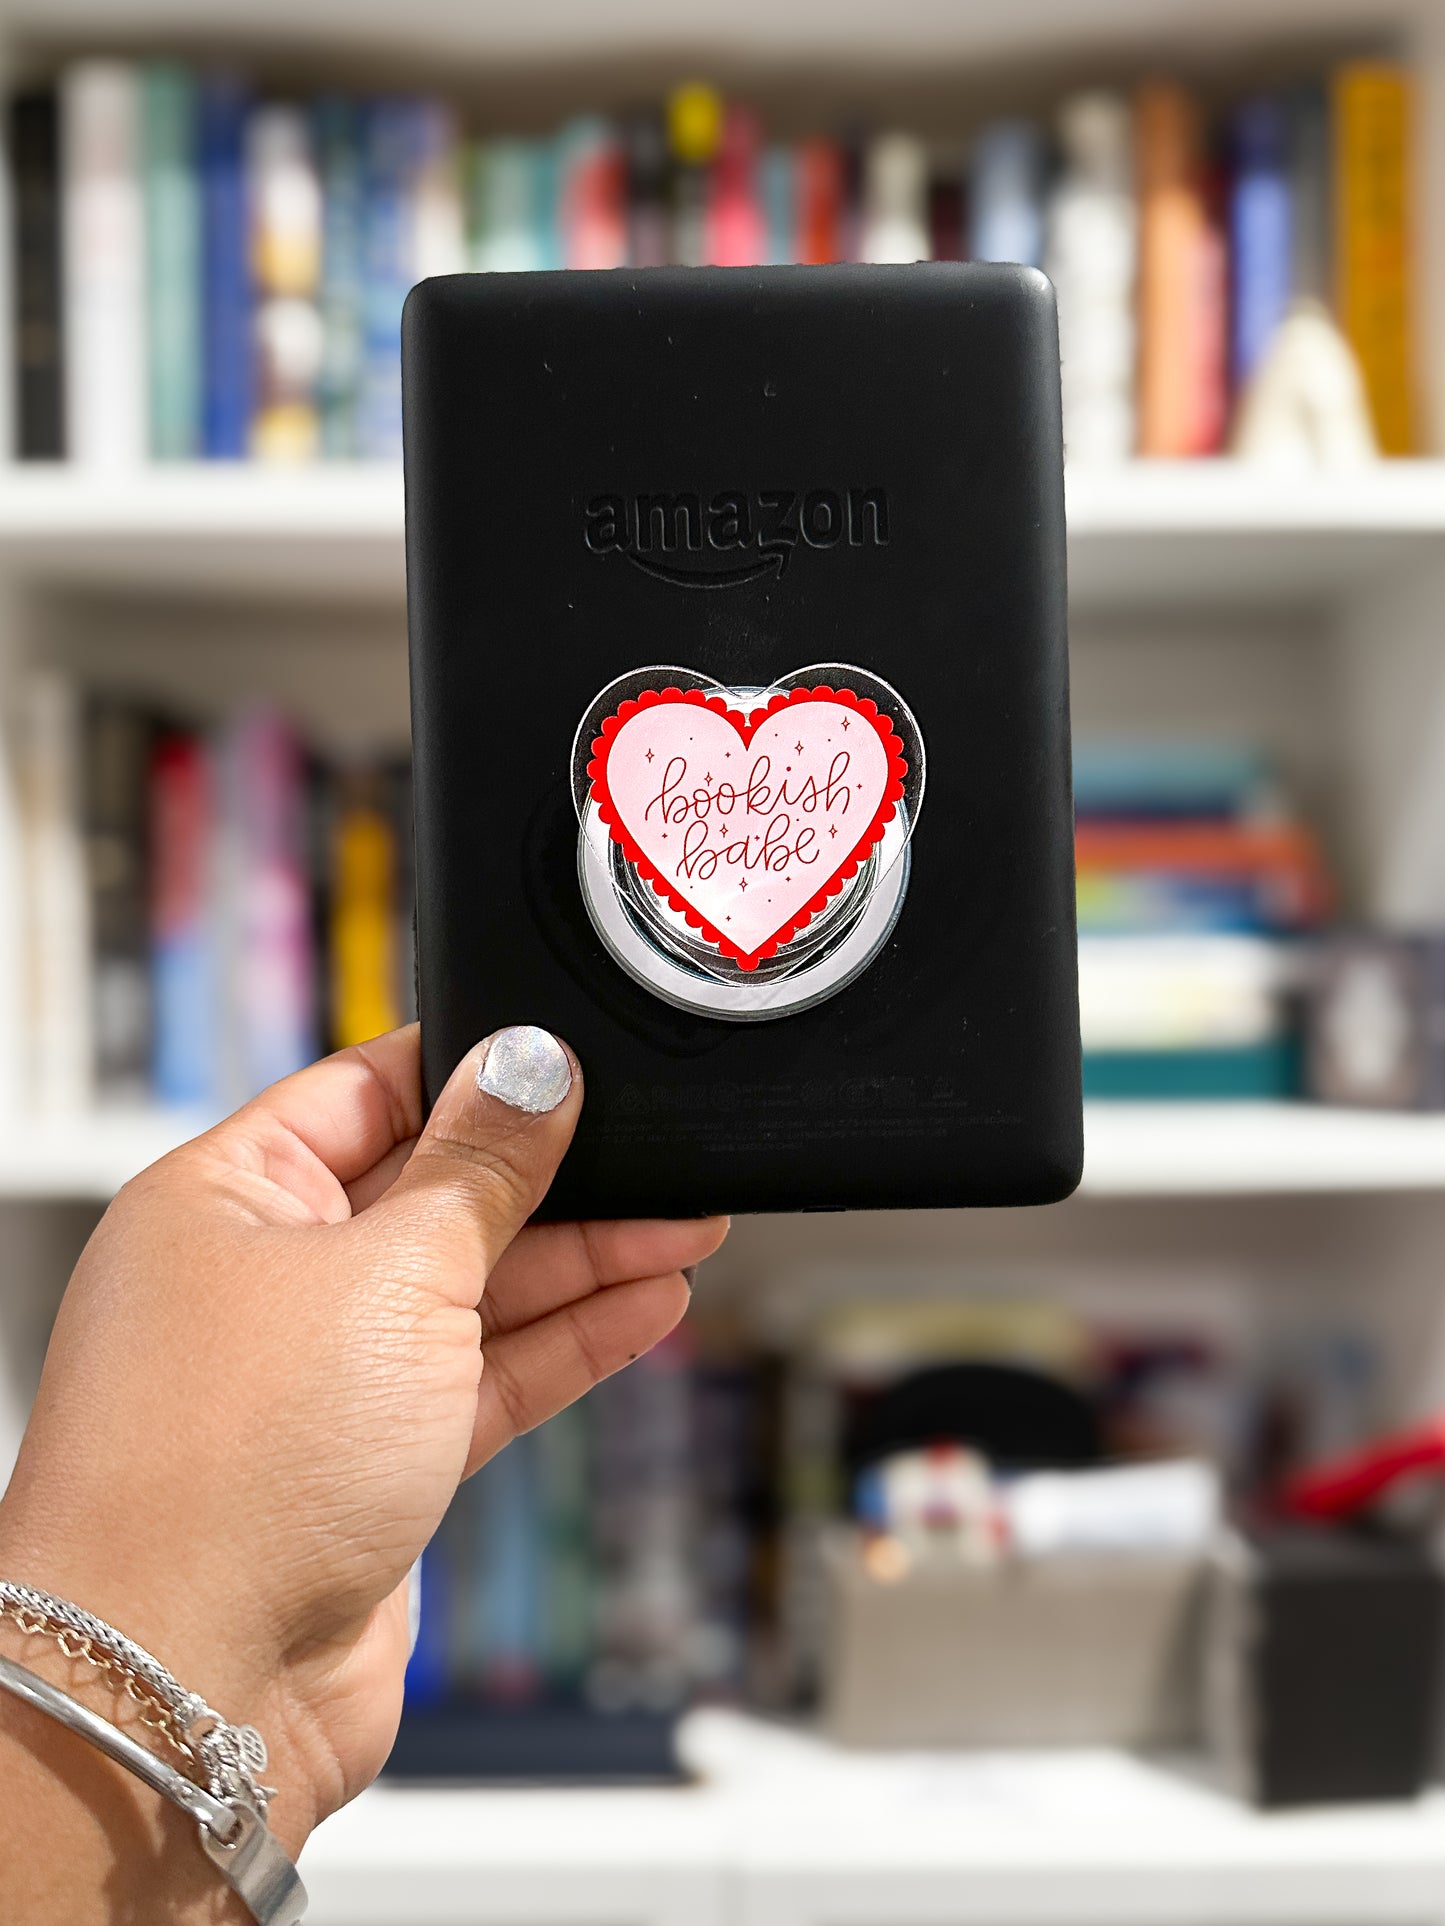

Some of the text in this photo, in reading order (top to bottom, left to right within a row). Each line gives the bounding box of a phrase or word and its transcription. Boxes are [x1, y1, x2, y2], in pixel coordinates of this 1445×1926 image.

[585, 489, 890, 552] amazon
[645, 751, 850, 823] bookish
[677, 813, 820, 880] babe
